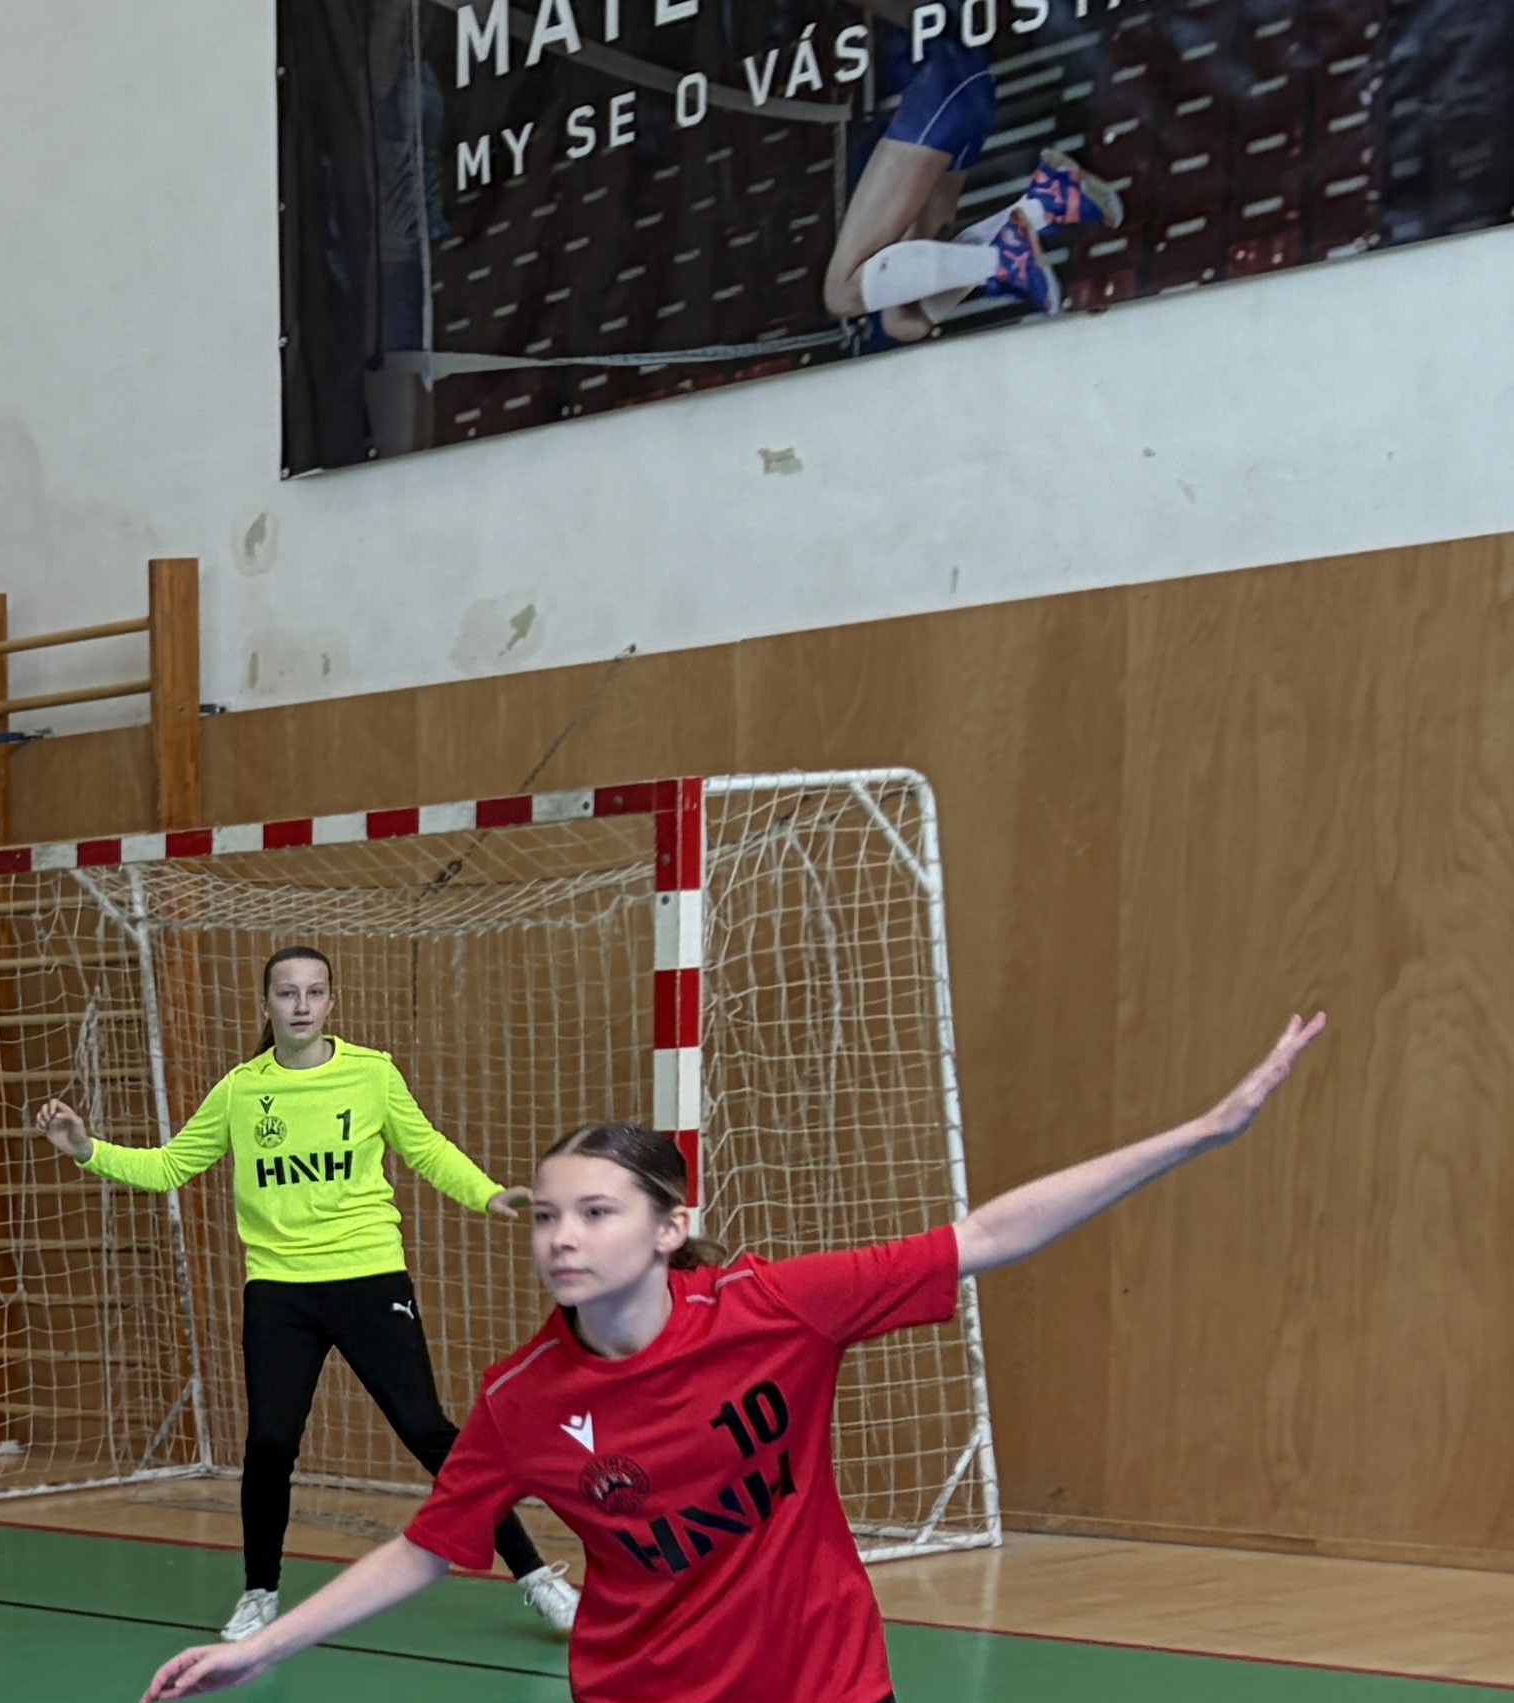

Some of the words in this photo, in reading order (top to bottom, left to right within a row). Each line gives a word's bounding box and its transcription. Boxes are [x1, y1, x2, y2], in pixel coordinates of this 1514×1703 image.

[457, 121, 535, 192] MY
[566, 90, 637, 159] SE
[675, 71, 708, 128] O
[743, 22, 871, 108] VÁS
[336, 1108, 352, 1141] 1
[256, 1150, 354, 1188] HNH
[710, 1379, 791, 1459] 10
[613, 1448, 798, 1574] HNH
